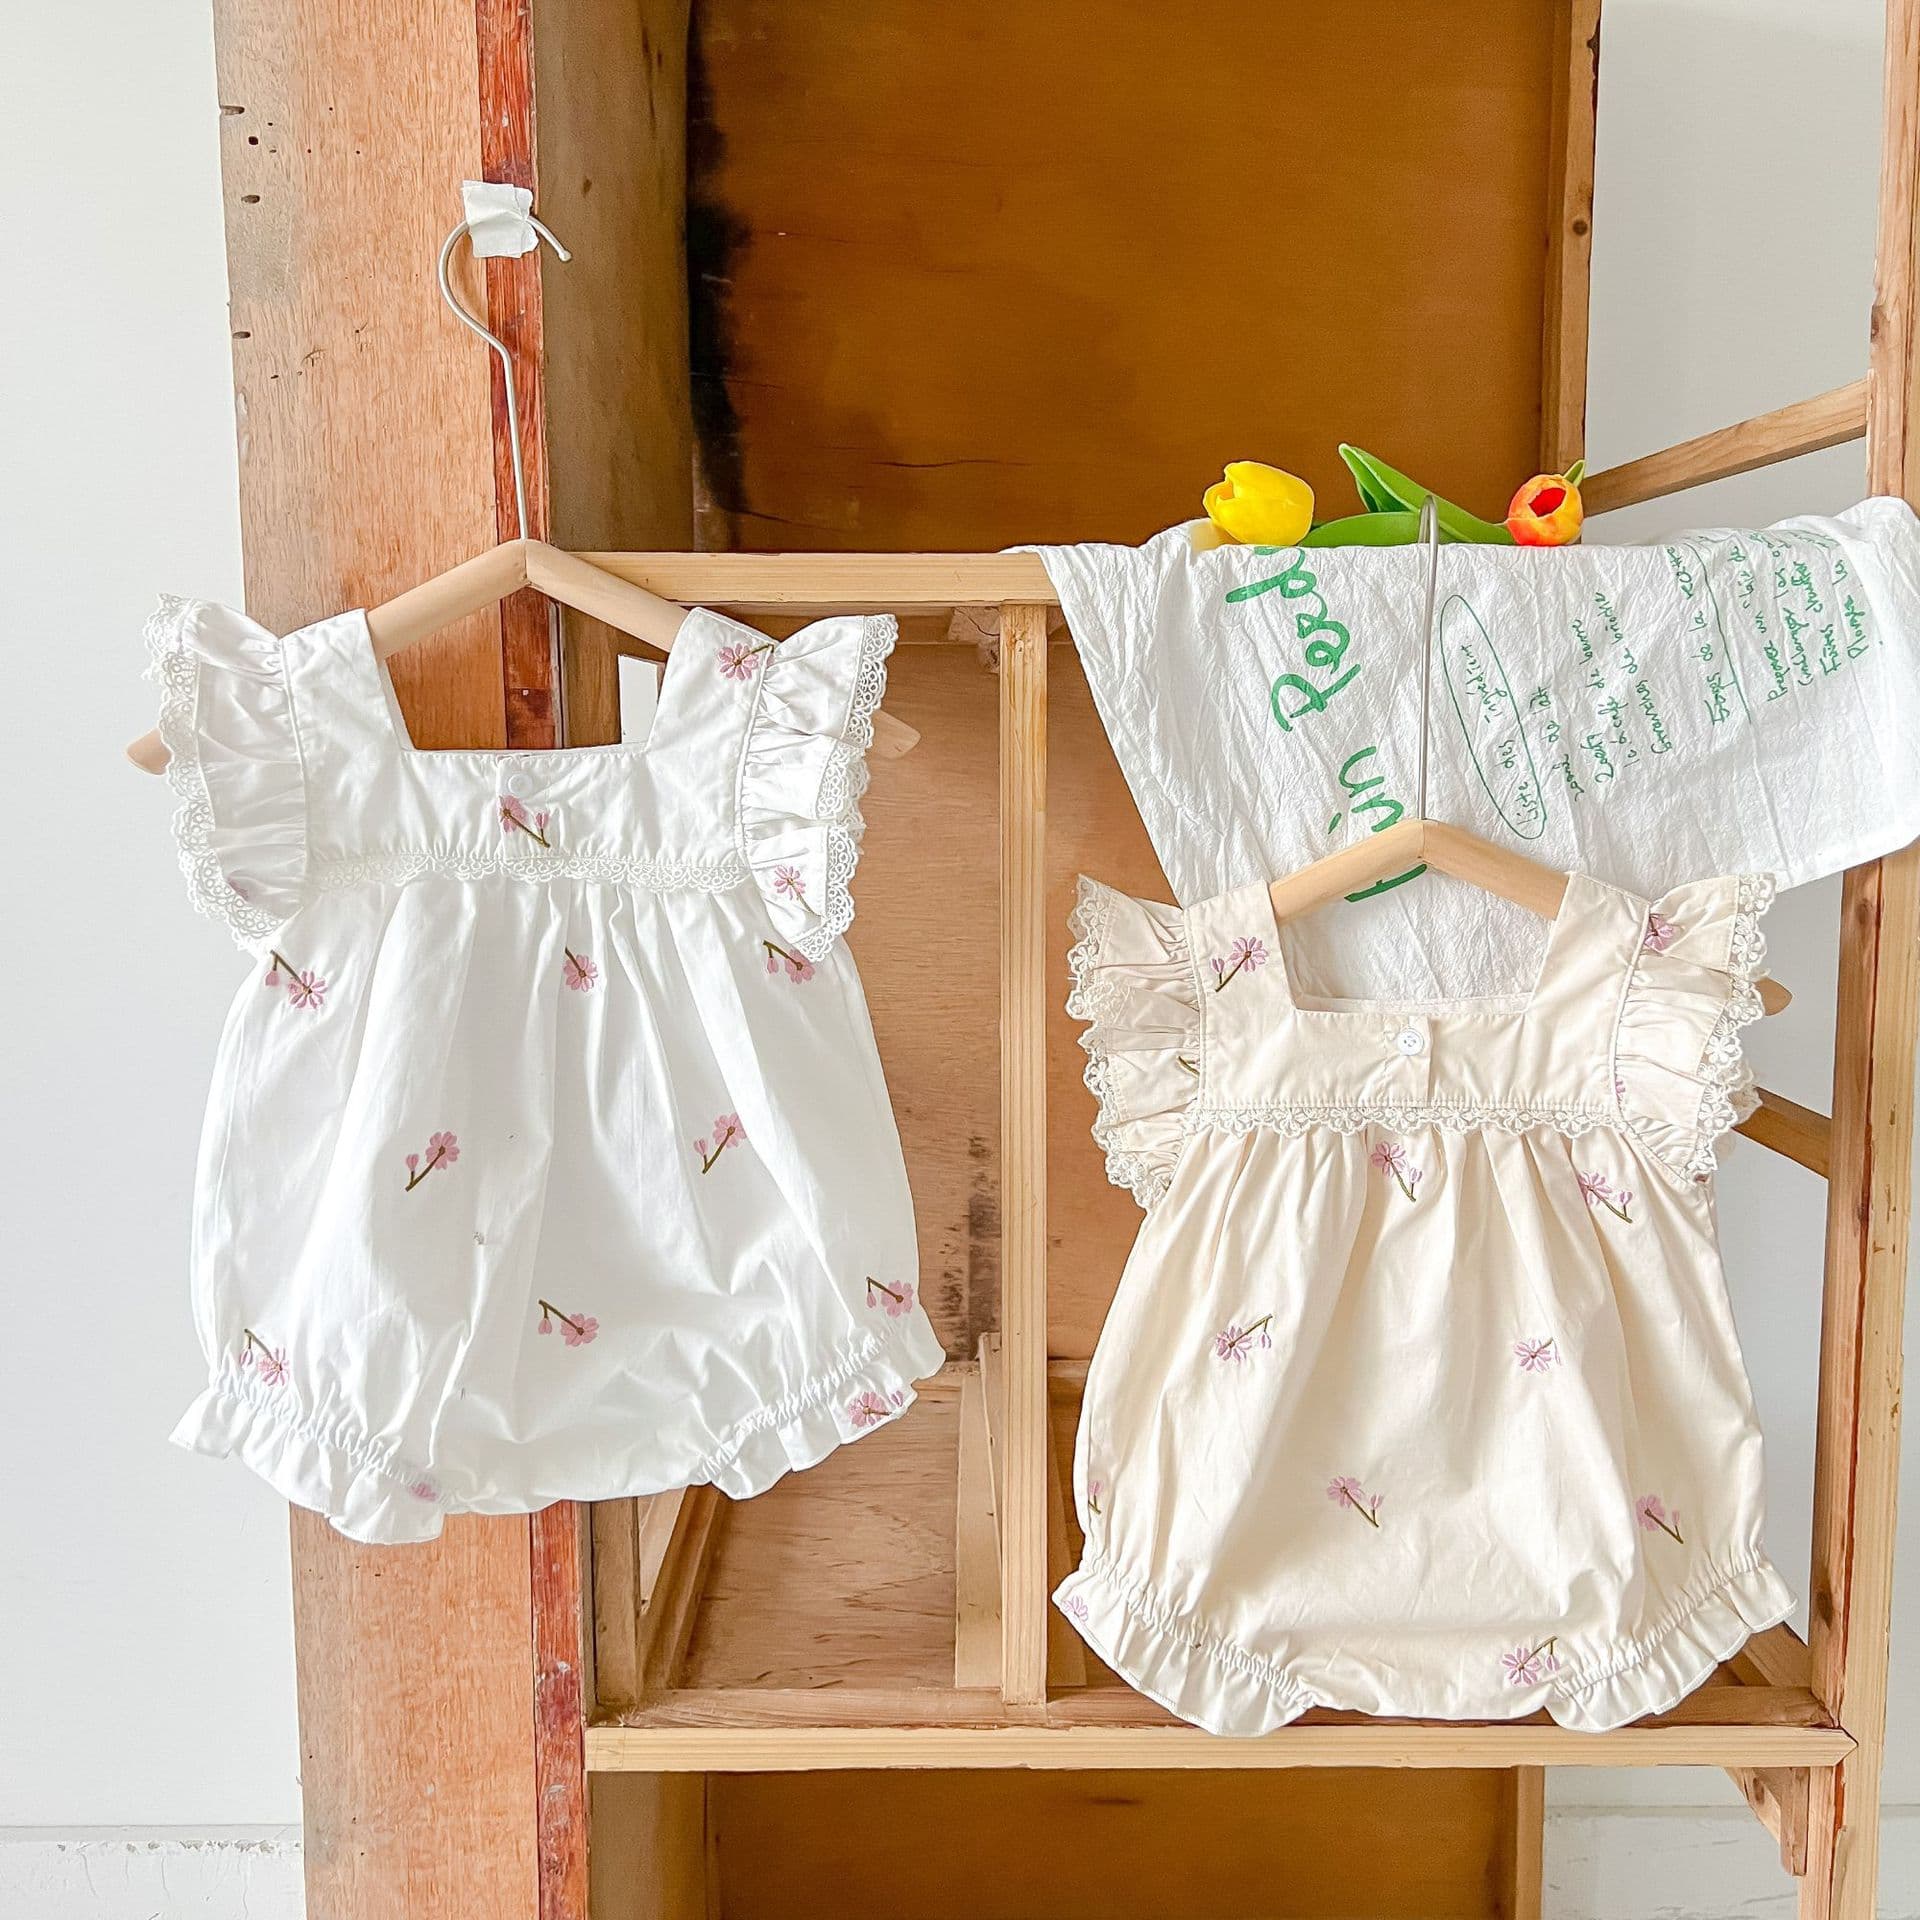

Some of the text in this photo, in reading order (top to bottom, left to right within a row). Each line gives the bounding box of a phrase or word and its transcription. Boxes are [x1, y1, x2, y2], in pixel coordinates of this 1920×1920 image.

[1688, 610, 1708, 632] la
[1225, 547, 1361, 731] Perd
[1690, 643, 1713, 662] de
[1540, 720, 1561, 743] de
[1498, 739, 1515, 769] des
